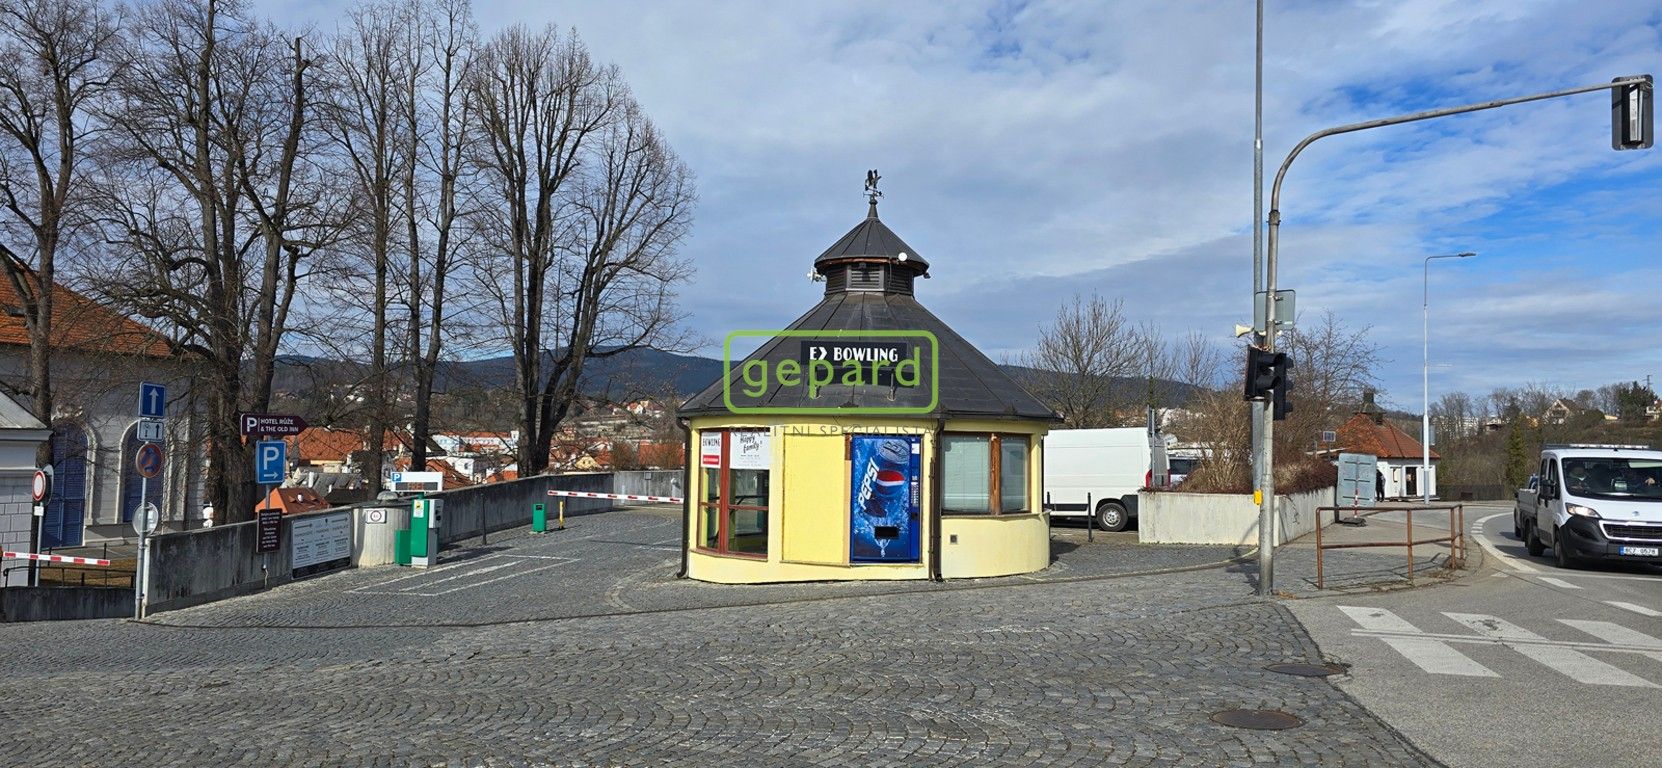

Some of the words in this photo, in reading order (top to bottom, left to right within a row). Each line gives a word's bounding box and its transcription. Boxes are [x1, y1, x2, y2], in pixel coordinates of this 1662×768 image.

[833, 347, 898, 362] BOWLING
[247, 417, 257, 432] P
[263, 446, 279, 470] P
[393, 473, 401, 481] P
[857, 457, 880, 511] PEPSI
